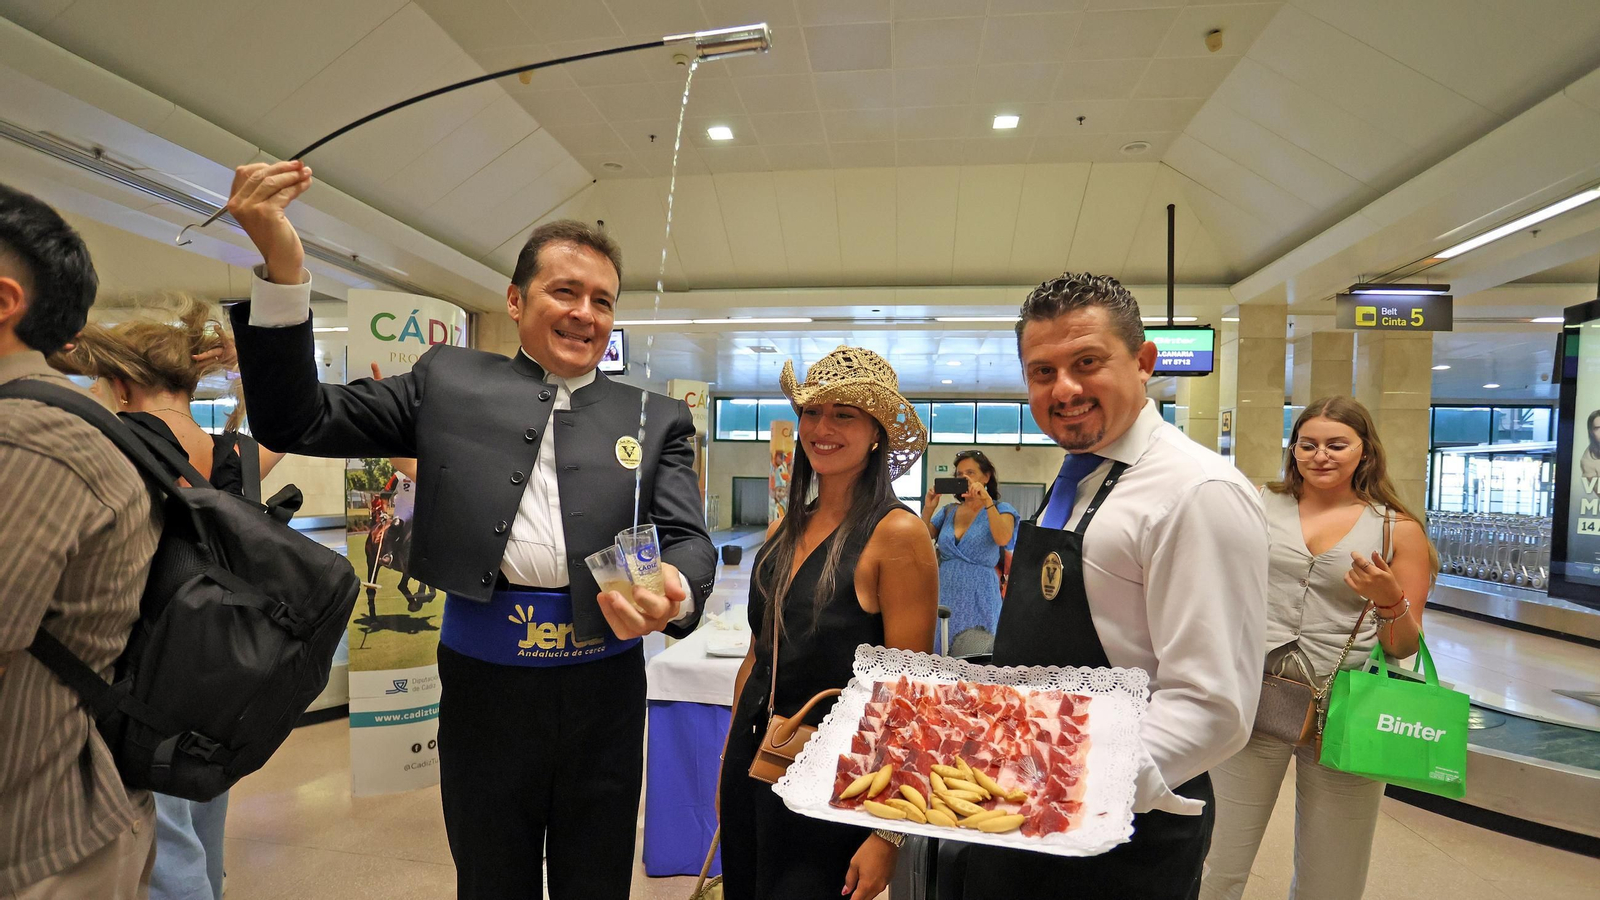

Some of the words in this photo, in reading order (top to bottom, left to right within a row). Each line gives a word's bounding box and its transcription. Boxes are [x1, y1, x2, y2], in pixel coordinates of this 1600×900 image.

[1381, 307, 1398, 316] Belt
[1381, 317, 1407, 326] Cinta
[1410, 308, 1424, 327] 5
[1046, 567, 1057, 584] V
[517, 649, 570, 658] Andalucía
[584, 645, 606, 655] cerca
[1376, 713, 1447, 743] Binter
